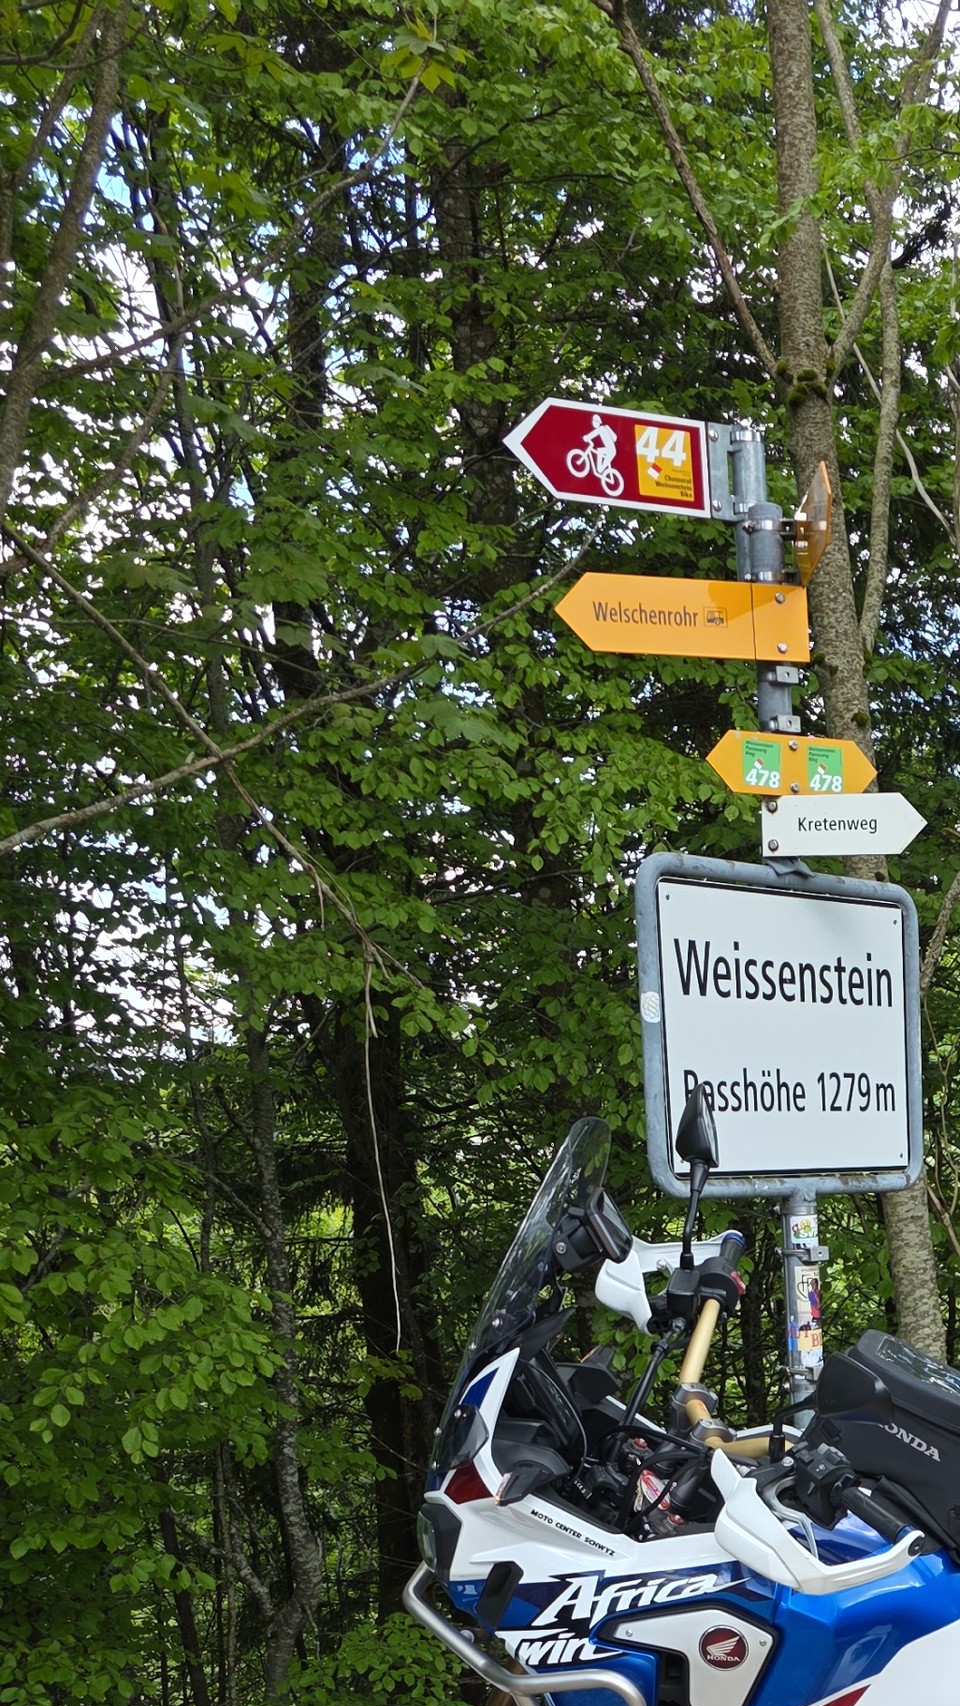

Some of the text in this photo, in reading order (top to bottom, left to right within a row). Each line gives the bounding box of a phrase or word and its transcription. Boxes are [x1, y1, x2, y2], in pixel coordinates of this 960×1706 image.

[637, 427, 687, 467] 44
[592, 601, 699, 627] Welschenrohr
[745, 768, 780, 789] 478
[809, 774, 842, 792] 478
[798, 817, 877, 834] Kretenweg
[673, 938, 893, 1007] Weissenstein
[683, 1068, 806, 1112] Passhöhe
[880, 1423, 941, 1462] ONDA
[530, 1509, 616, 1557] MOTO CENTER SCHWYZ
[531, 1573, 751, 1629] Africa
[495, 1628, 624, 1675] Twin
